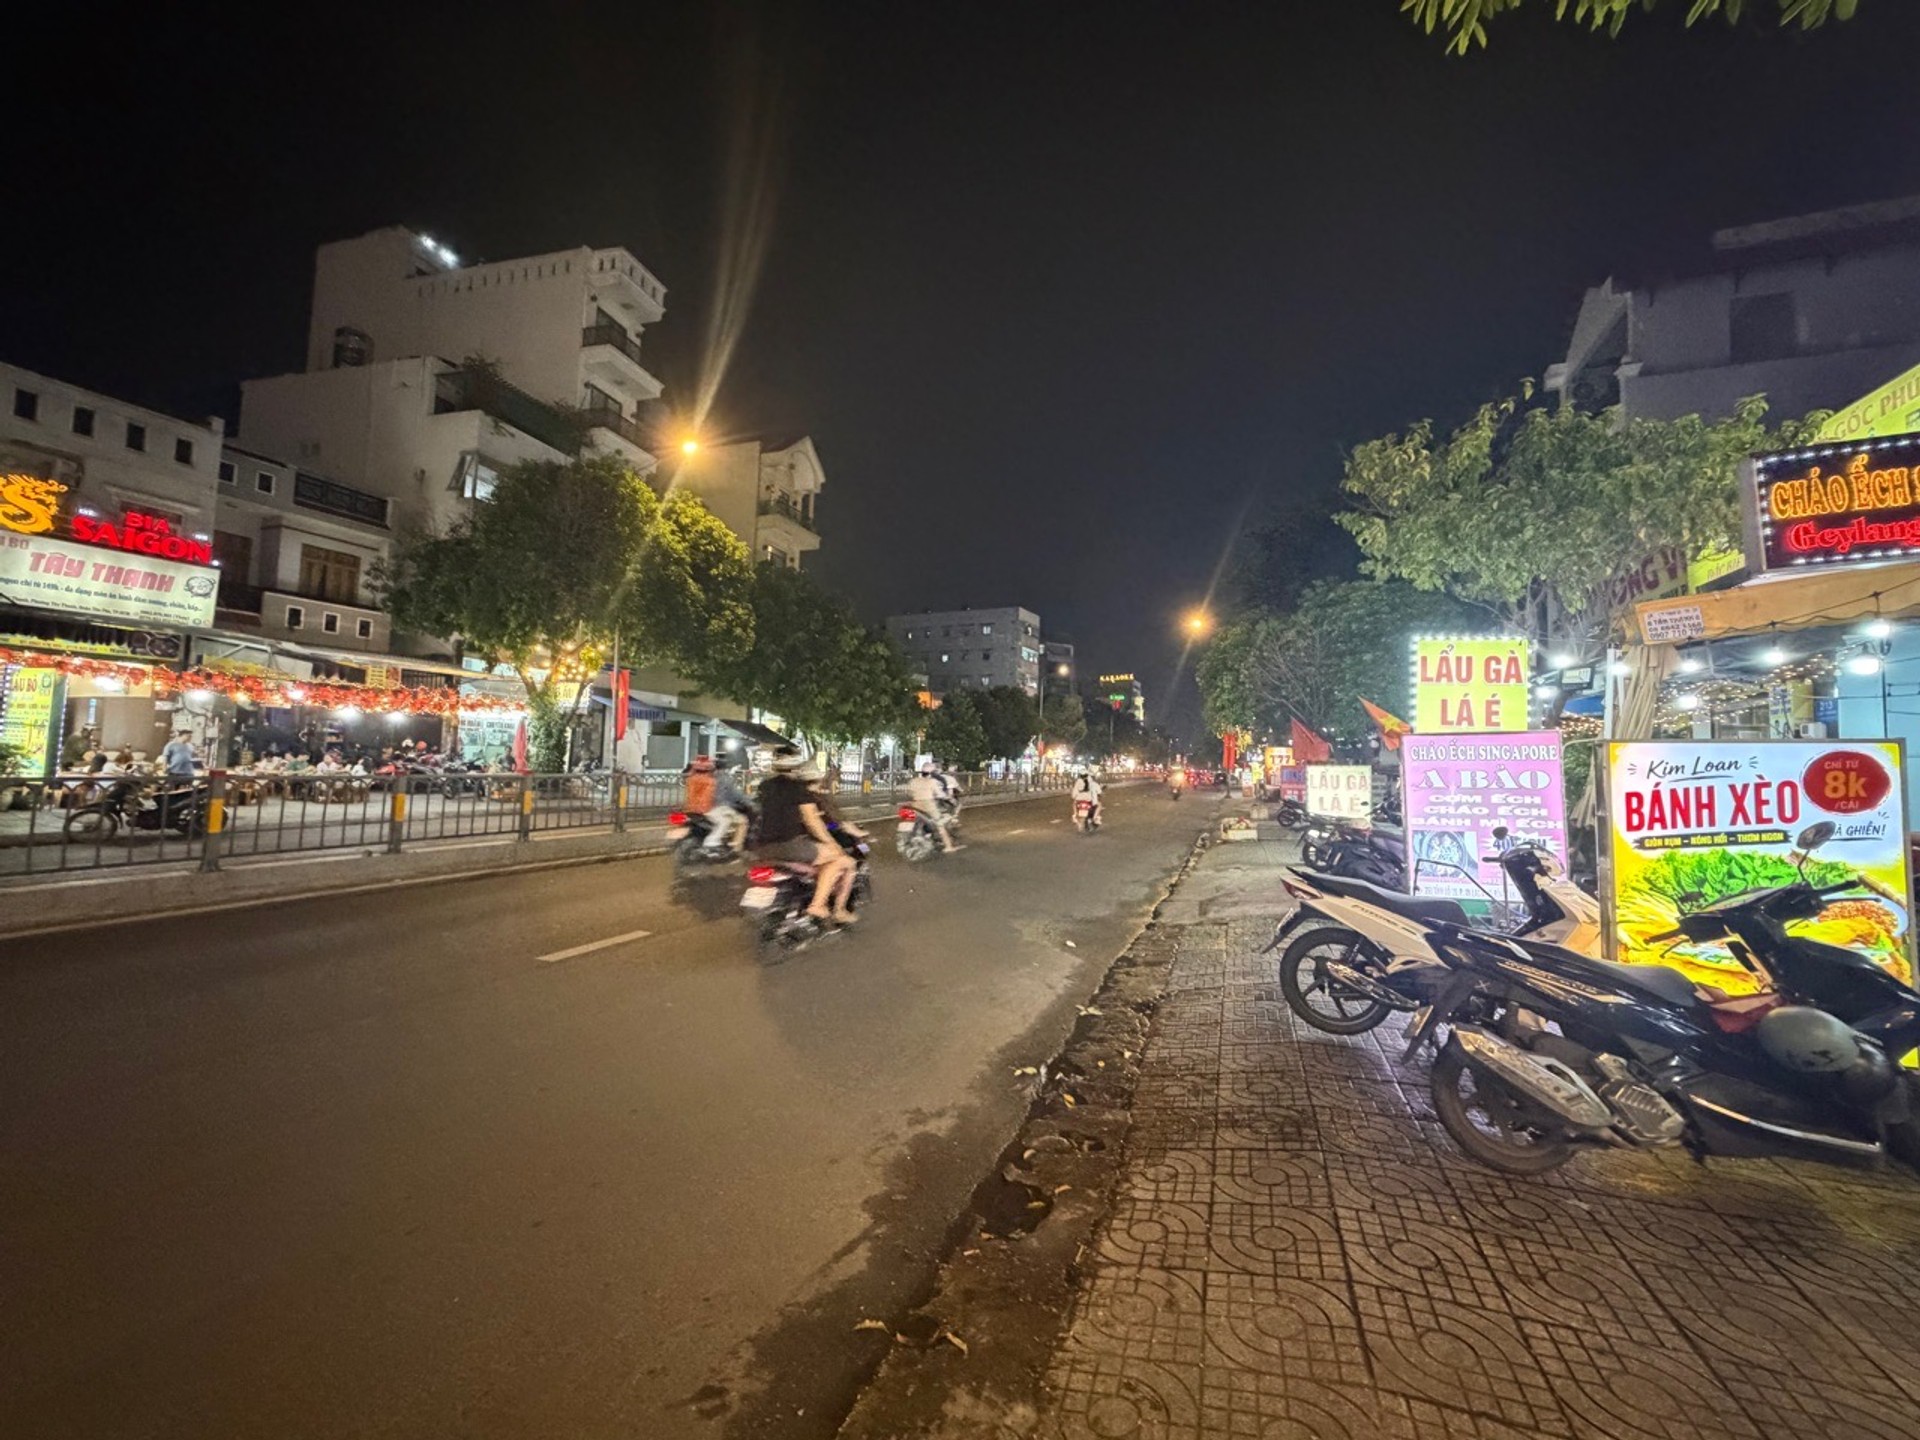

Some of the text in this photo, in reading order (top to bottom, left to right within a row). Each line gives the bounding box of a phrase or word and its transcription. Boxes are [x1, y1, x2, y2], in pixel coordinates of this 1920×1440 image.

[125, 511, 171, 534] BIA
[71, 515, 213, 564] SAIGON
[29, 552, 86, 578] TÂY
[1420, 645, 1522, 684] LẨU GÀ
[1440, 693, 1501, 727] LÁ É
[1478, 744, 1559, 761] SINGAPORE
[1417, 768, 1449, 788] A
[1646, 755, 1742, 780] Kim Loan
[1347, 771, 1368, 791] GÀ
[1824, 771, 1868, 798] 8k
[1625, 774, 1800, 832] BÁNH XÈO
